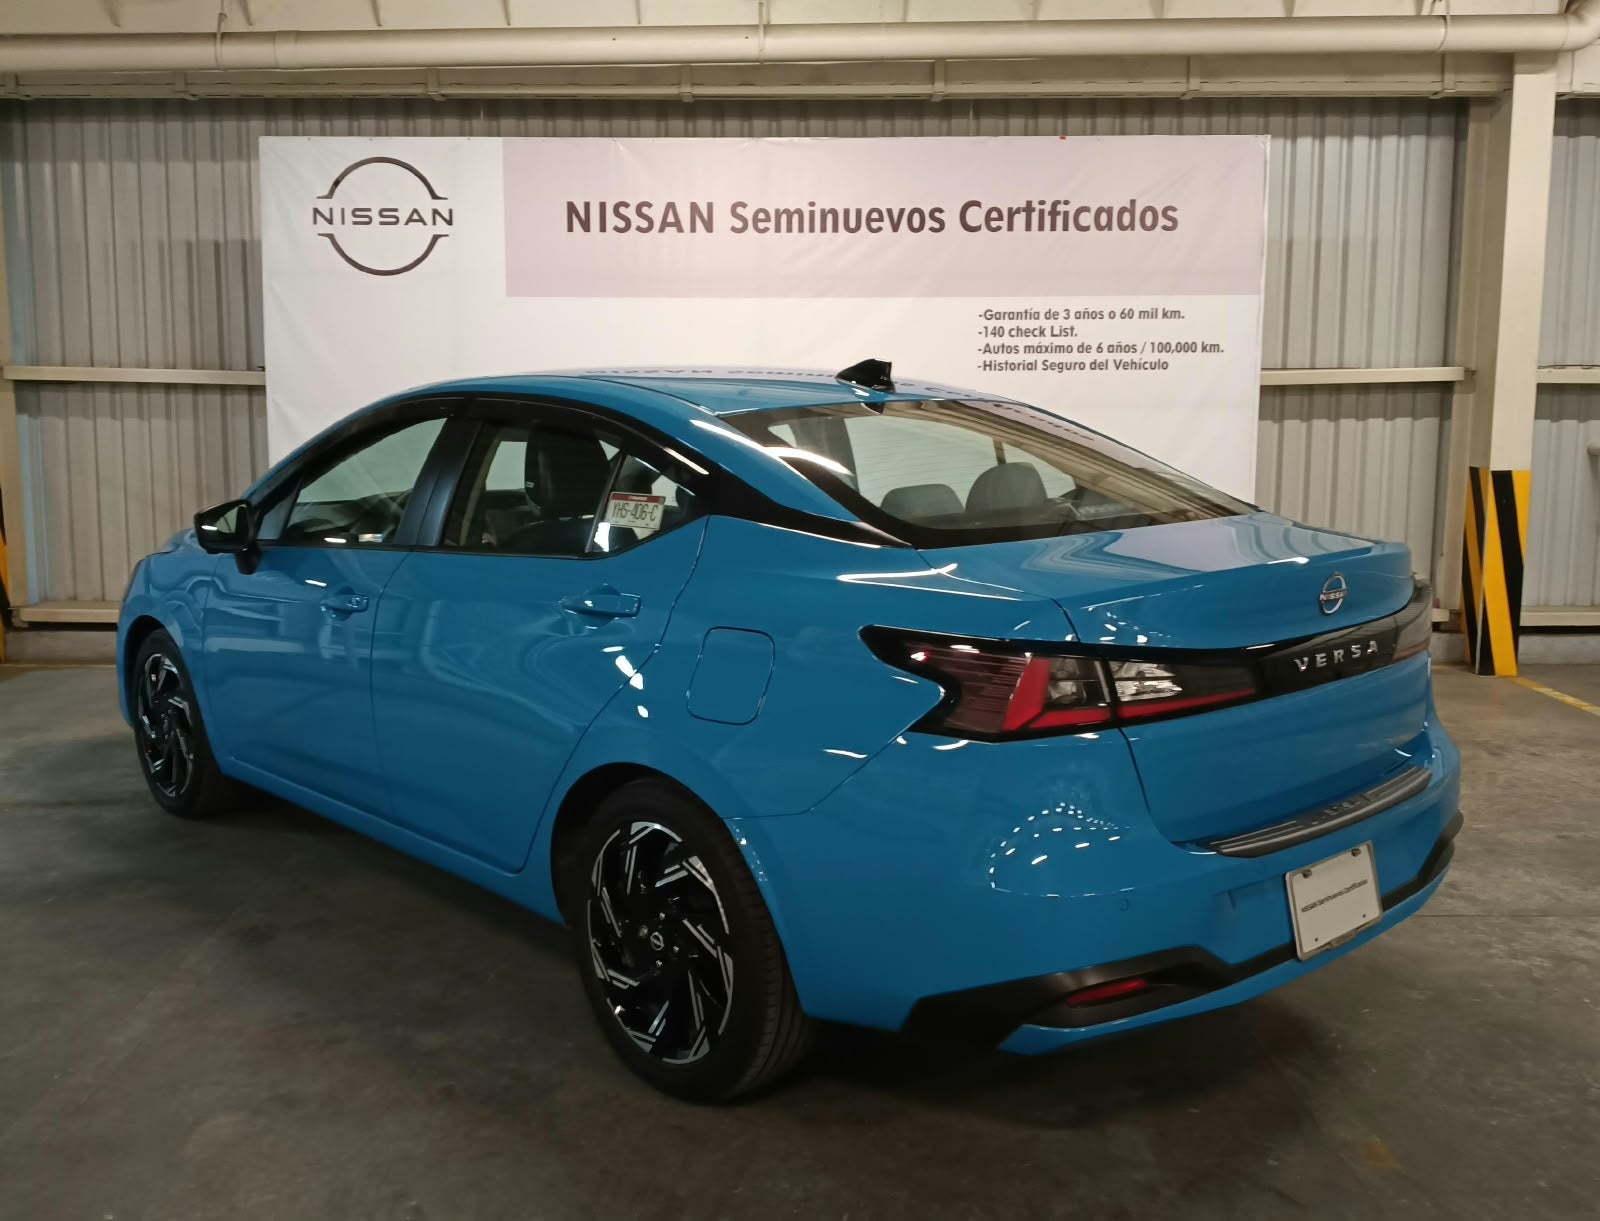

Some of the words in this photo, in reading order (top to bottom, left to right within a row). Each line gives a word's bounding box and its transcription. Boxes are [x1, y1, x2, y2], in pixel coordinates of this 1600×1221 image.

[312, 207, 453, 226] NISSAN
[566, 201, 713, 234] NISSAN
[730, 201, 946, 234] Seminuevos
[960, 198, 1178, 233] Certificados
[978, 307, 1040, 321] -Garantía
[1044, 308, 1060, 321] de
[1063, 308, 1071, 321] 3
[1075, 307, 1105, 320] años
[1108, 310, 1117, 320] o
[1119, 308, 1135, 320] 60
[1138, 308, 1159, 320] mil
[1162, 307, 1185, 320] km.
[978, 326, 1005, 338] -140
[1008, 325, 1046, 338] check
[1050, 325, 1078, 338] List.
[977, 342, 1020, 355] -Autos
[1023, 341, 1074, 354] máximo
[1077, 342, 1093, 354] de
[1095, 342, 1104, 354] 6
[1107, 341, 1138, 354] años
[1140, 341, 1147, 354] /
[1150, 341, 1198, 355] 100,000
[1201, 341, 1224, 353] km.
[977, 359, 1038, 372] -Historial
[1042, 359, 1086, 374] Seguro
[1089, 358, 1109, 371] del
[1113, 358, 1169, 371] Vehículo
[1294, 640, 1378, 672] VERSA
